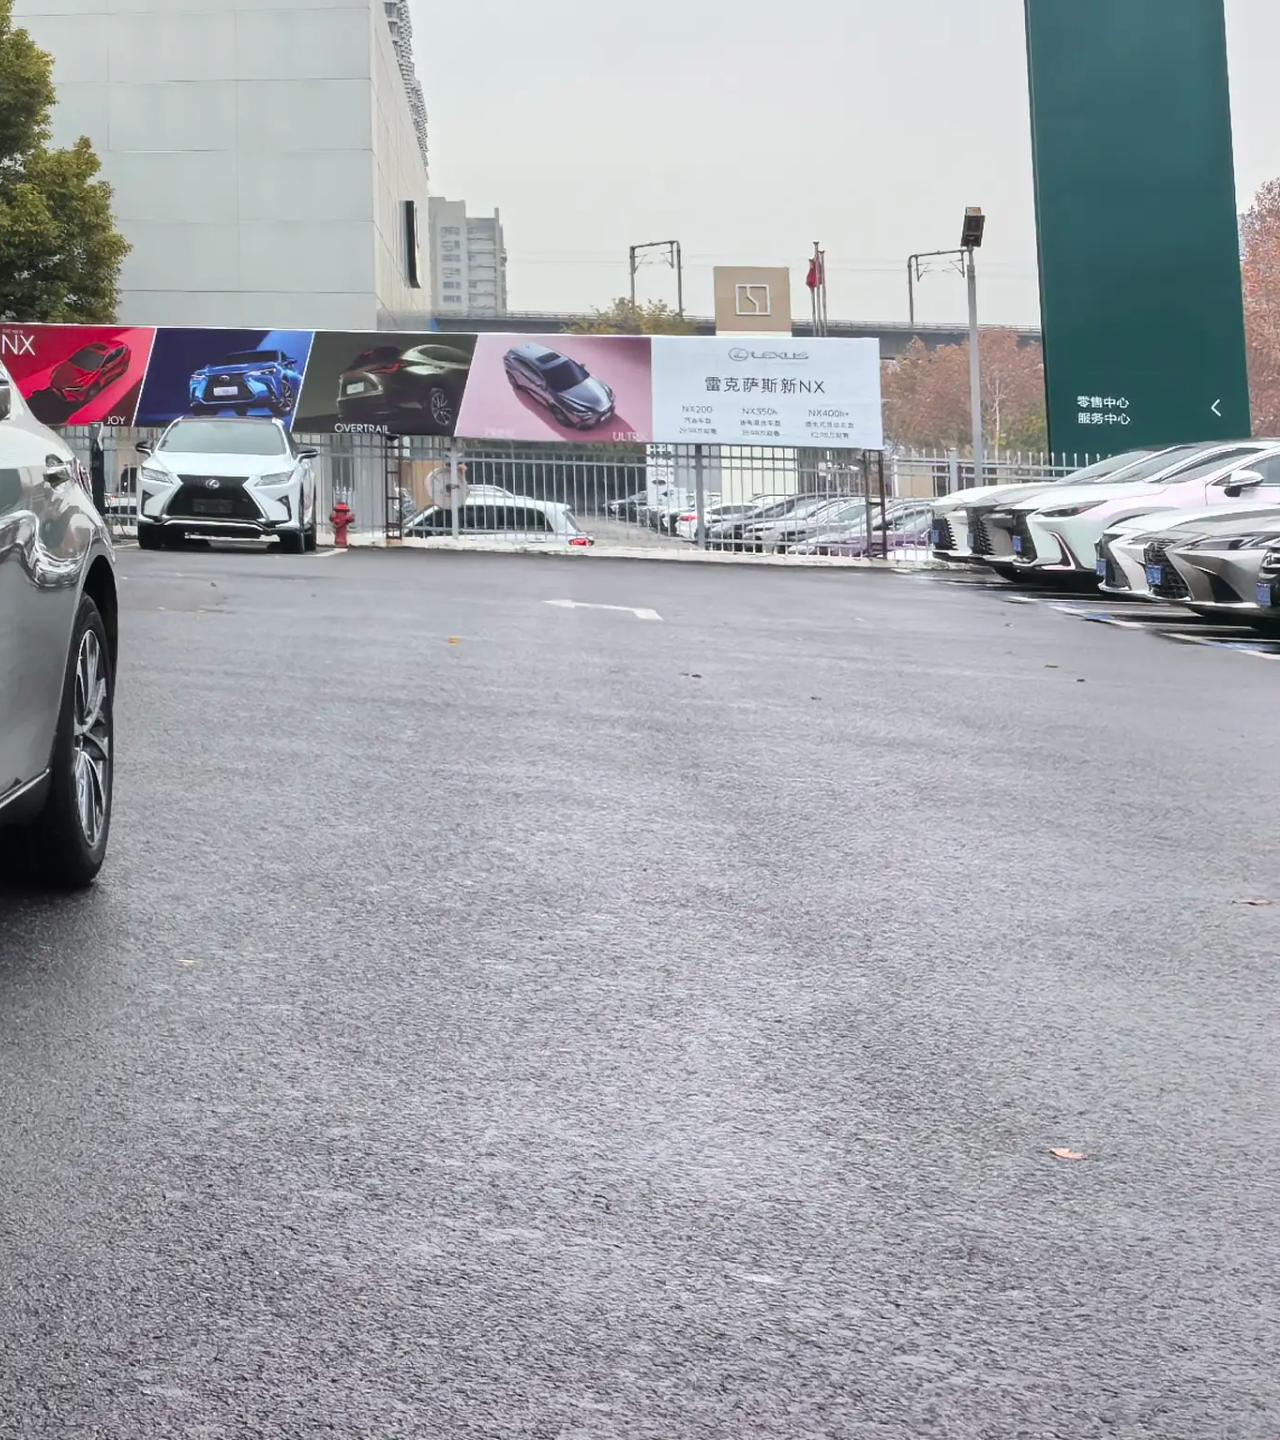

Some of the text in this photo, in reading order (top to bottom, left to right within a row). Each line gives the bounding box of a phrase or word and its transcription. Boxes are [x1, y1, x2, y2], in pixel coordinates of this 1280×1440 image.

[2, 334, 36, 357] NX
[704, 376, 826, 395] 雷克萨斯新NX
[1076, 395, 1130, 409] 零售中心
[106, 415, 127, 425] JOY
[1078, 412, 1131, 425] 服务中心
[334, 423, 390, 435] OVERTRAIL
